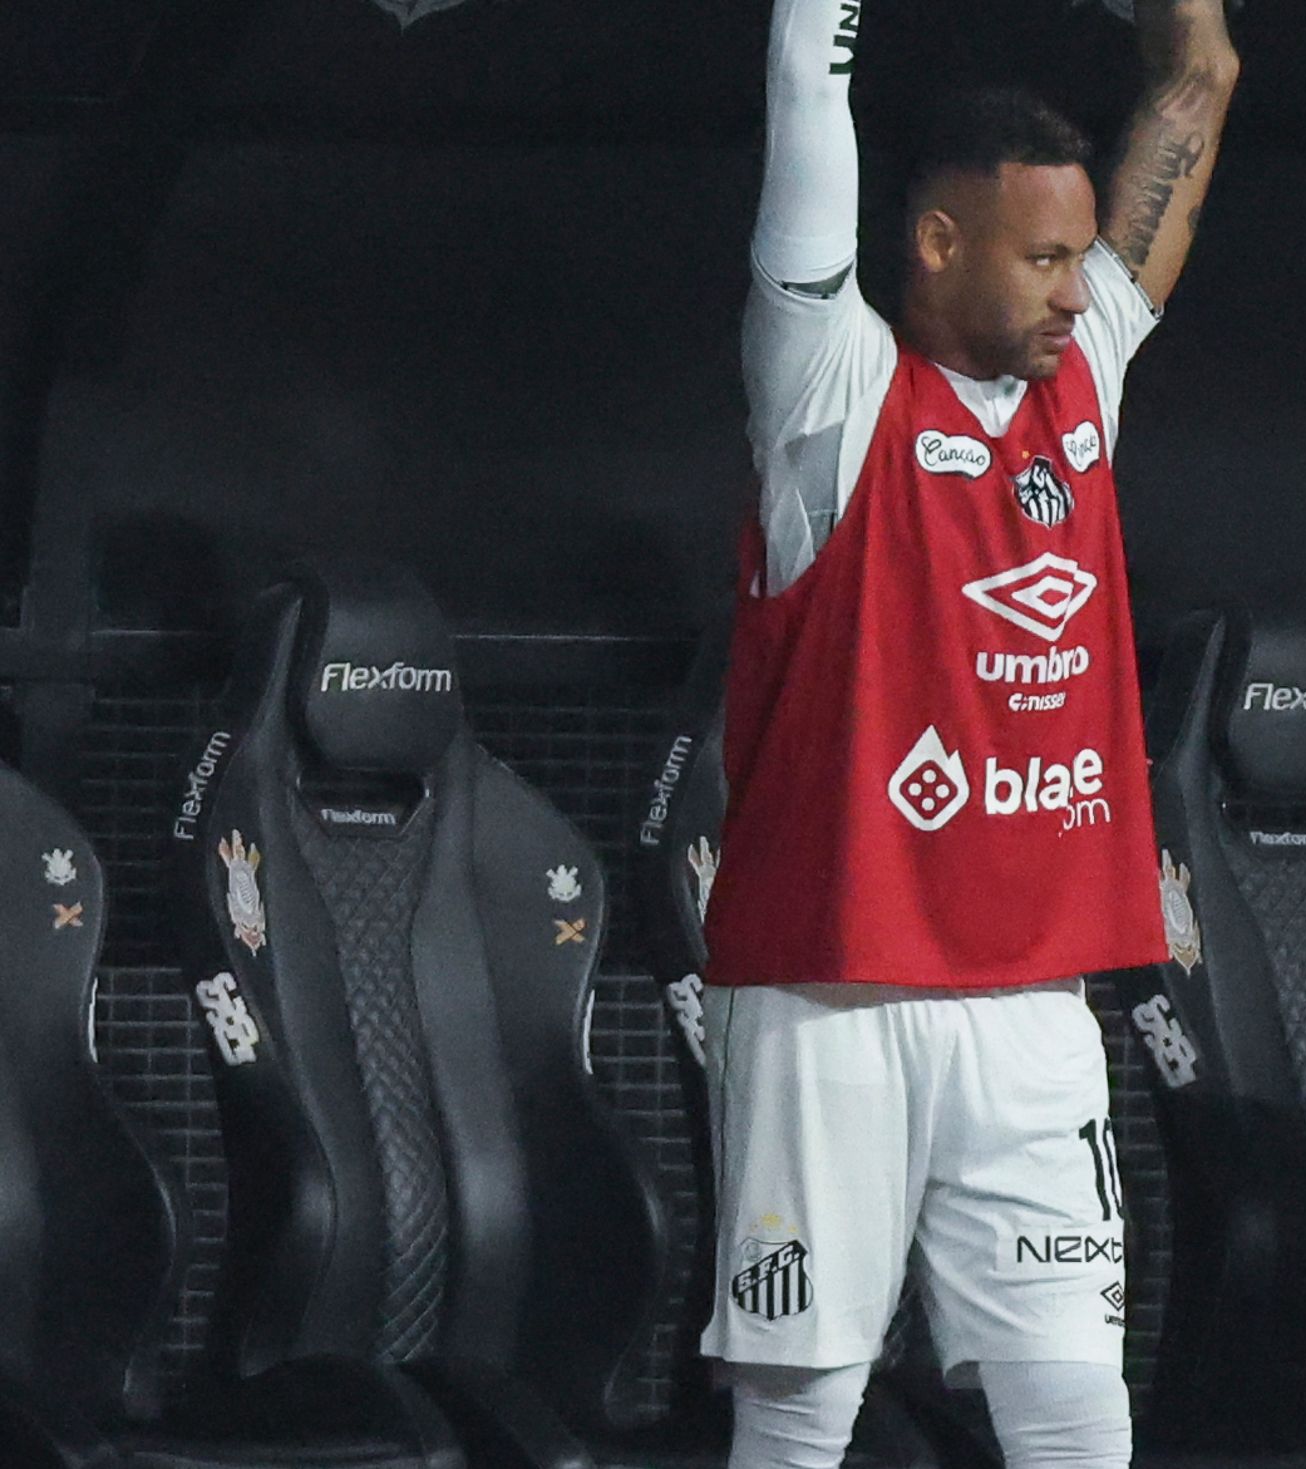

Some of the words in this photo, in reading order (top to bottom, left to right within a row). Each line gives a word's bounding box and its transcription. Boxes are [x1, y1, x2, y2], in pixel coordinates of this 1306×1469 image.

[321, 662, 451, 692] Flexform
[976, 645, 1089, 684] umbro
[173, 731, 231, 839] Flexform
[640, 735, 692, 845] Flexform
[985, 749, 1102, 815] blae
